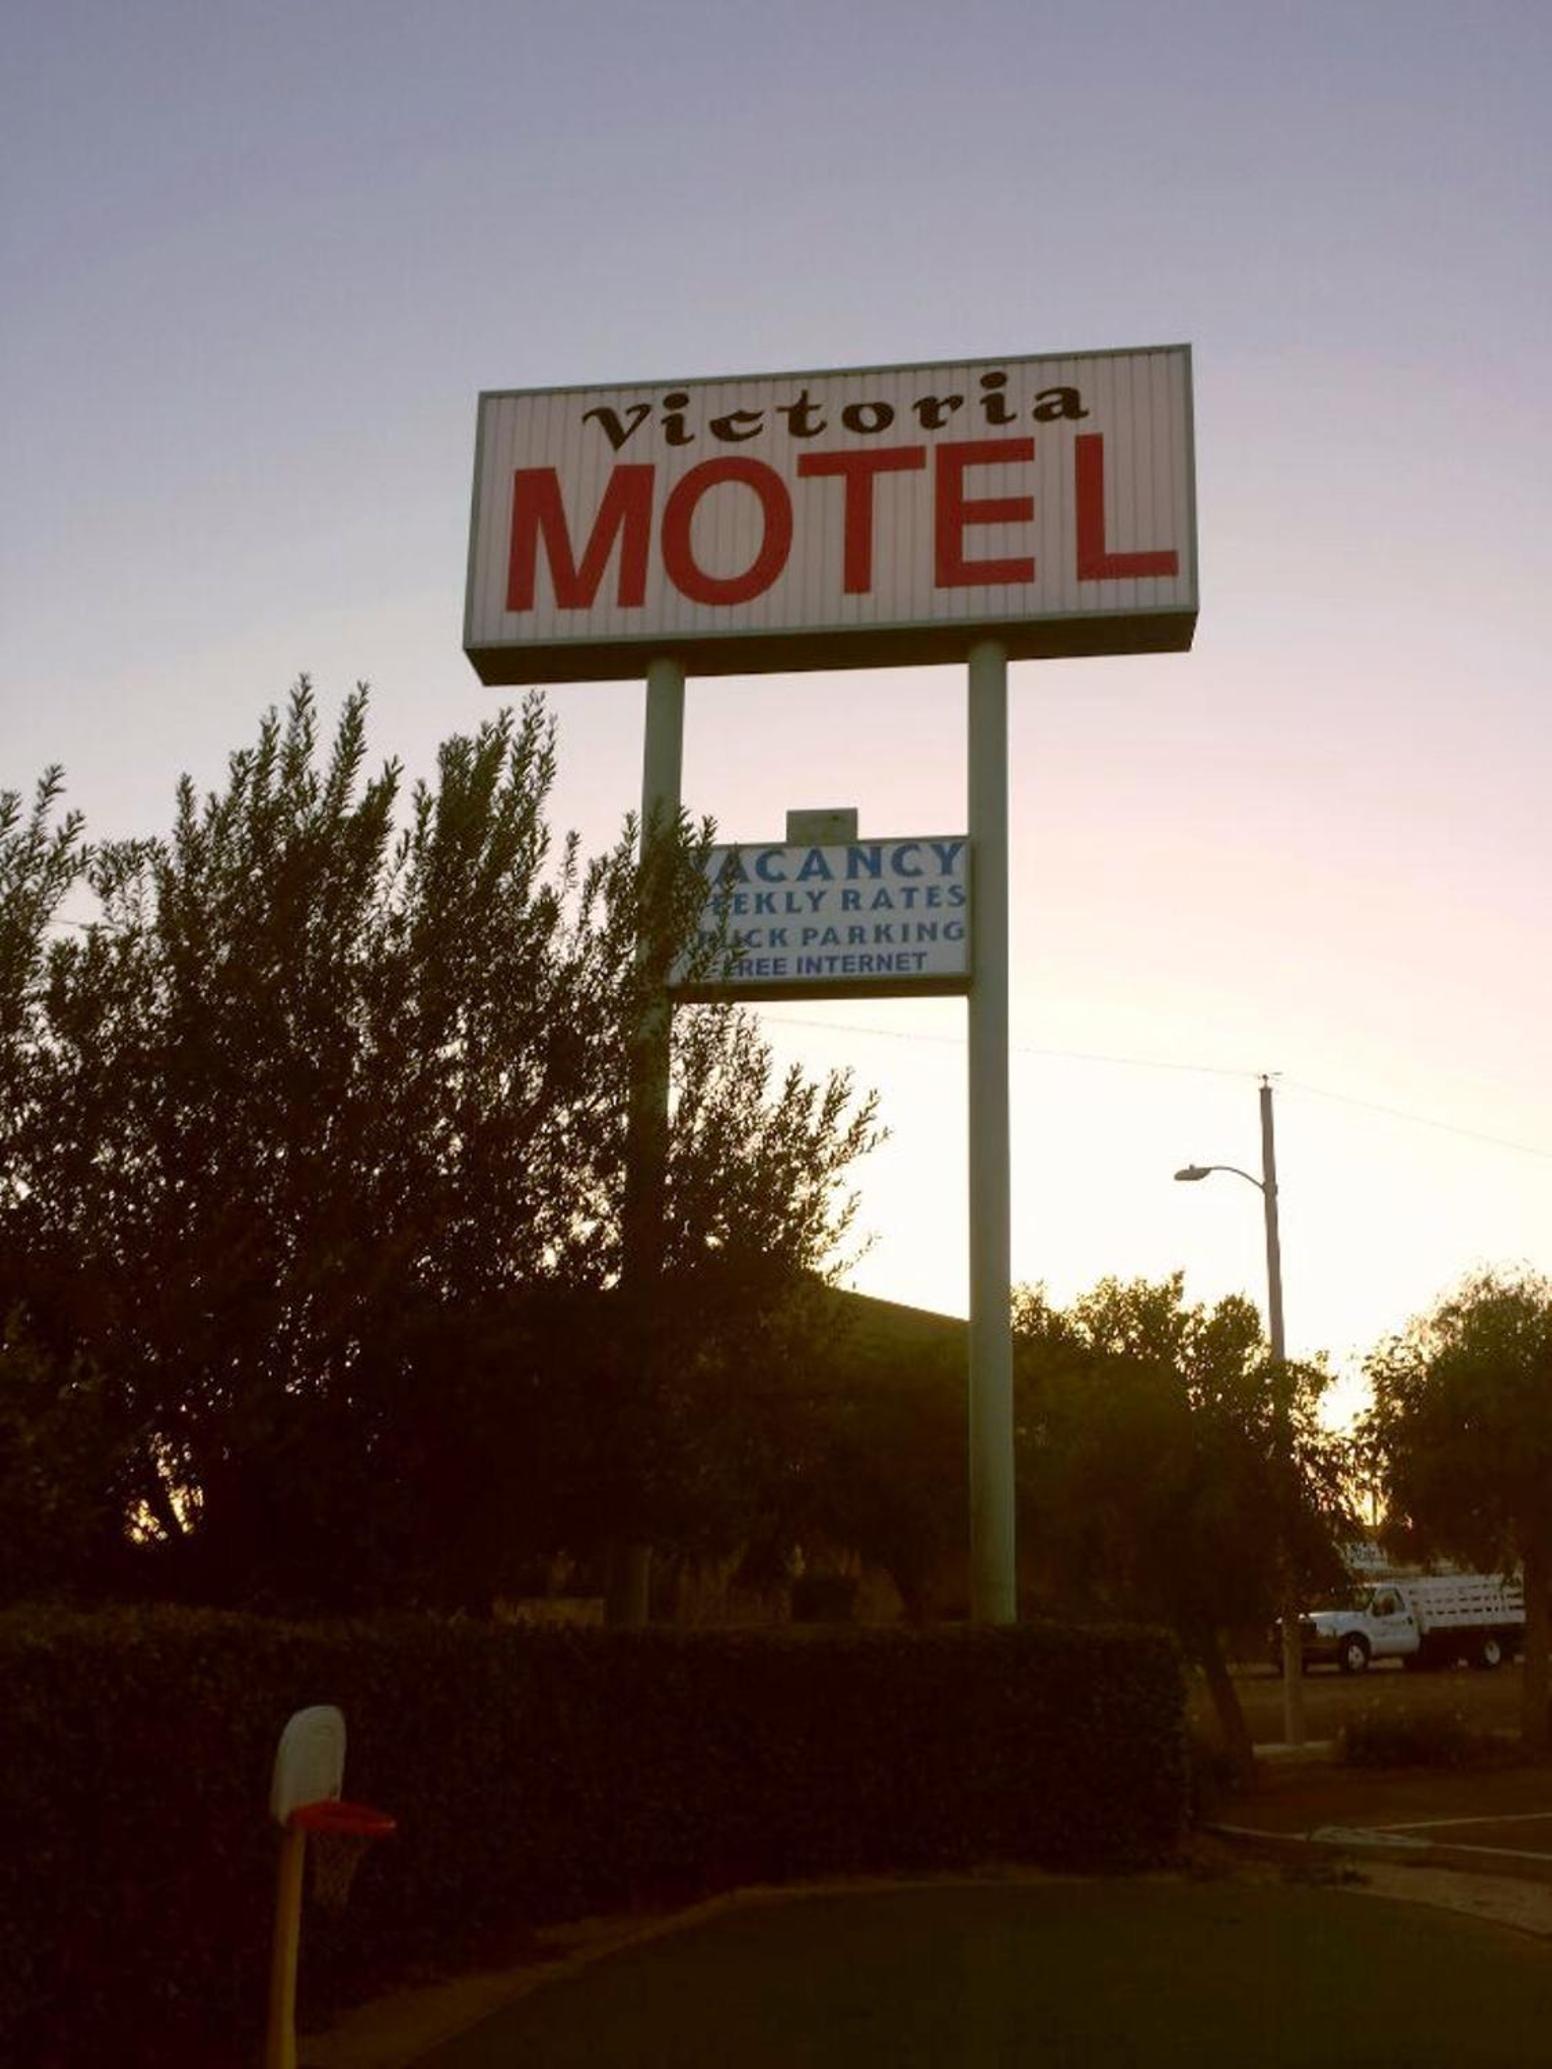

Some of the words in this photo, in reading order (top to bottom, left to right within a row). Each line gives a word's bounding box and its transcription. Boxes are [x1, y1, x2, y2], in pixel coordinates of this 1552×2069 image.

[582, 371, 1089, 451] Victoria
[505, 432, 1180, 612] MOTEL
[711, 889, 827, 916] EEKLY
[841, 884, 967, 912] RATES
[801, 921, 965, 948] PARKING
[796, 952, 928, 974] INTERNET
